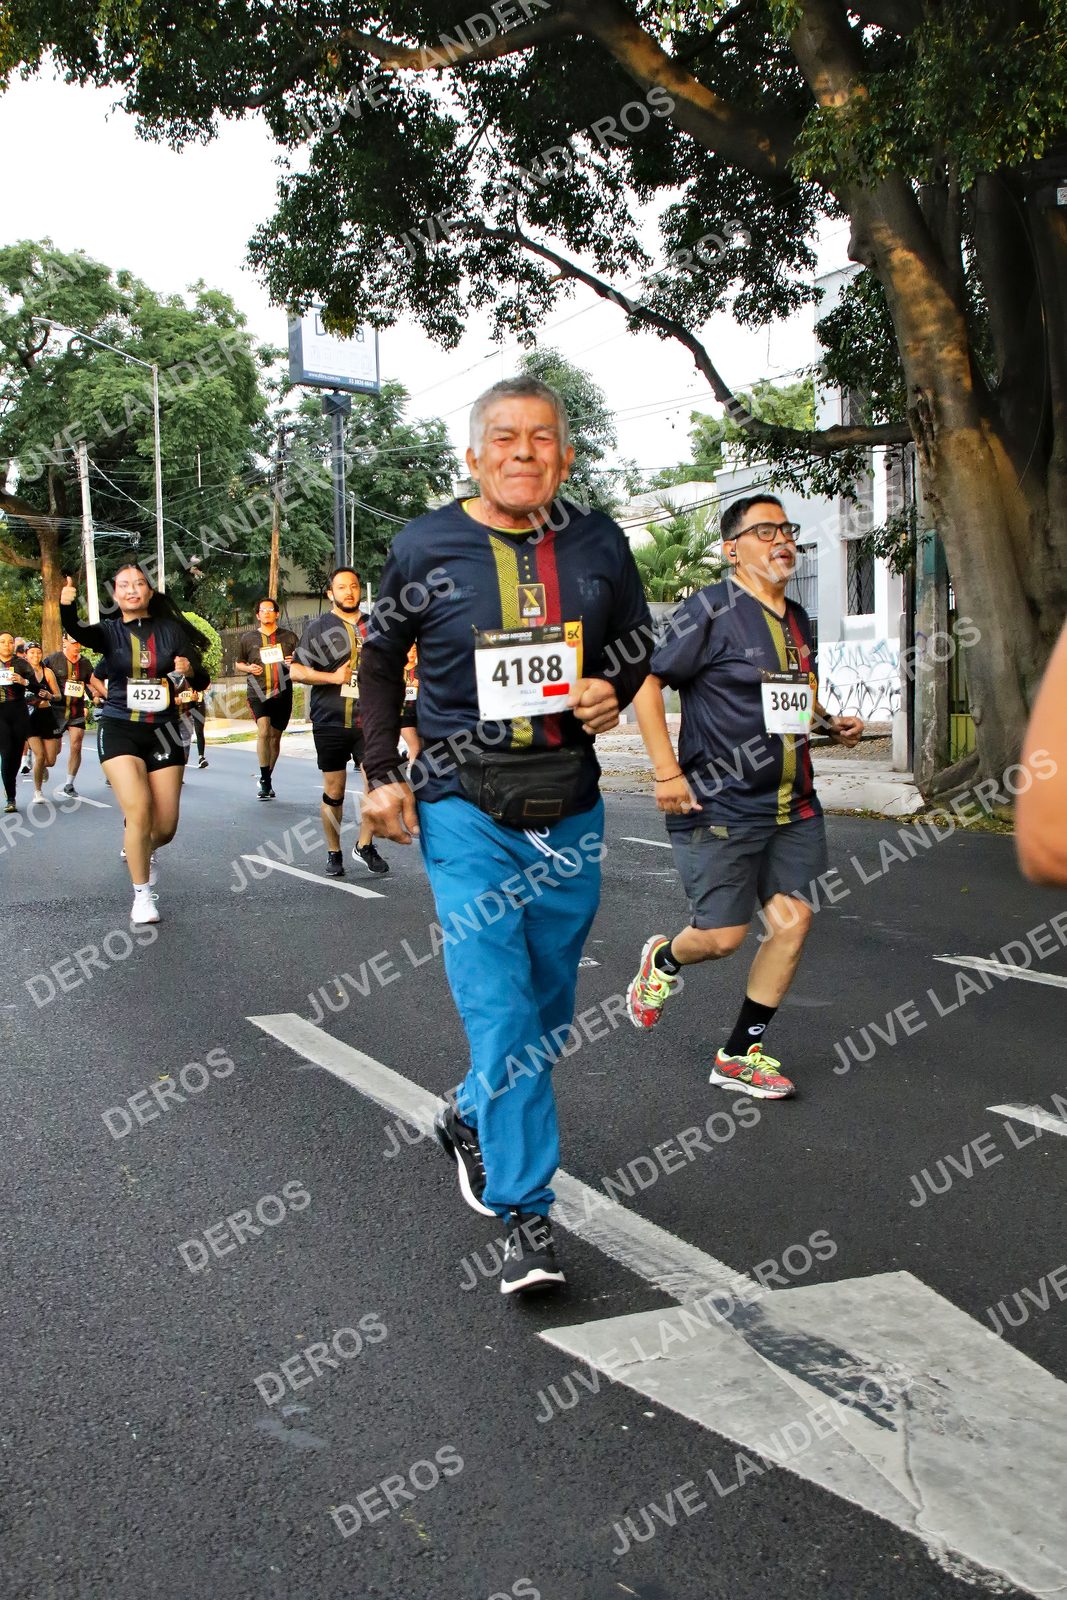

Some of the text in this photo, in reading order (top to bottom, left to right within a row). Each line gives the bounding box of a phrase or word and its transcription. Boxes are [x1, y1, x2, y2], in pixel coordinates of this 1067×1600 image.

[491, 654, 563, 687] 4188
[133, 689, 161, 700] 4522
[771, 691, 807, 711] 3840
